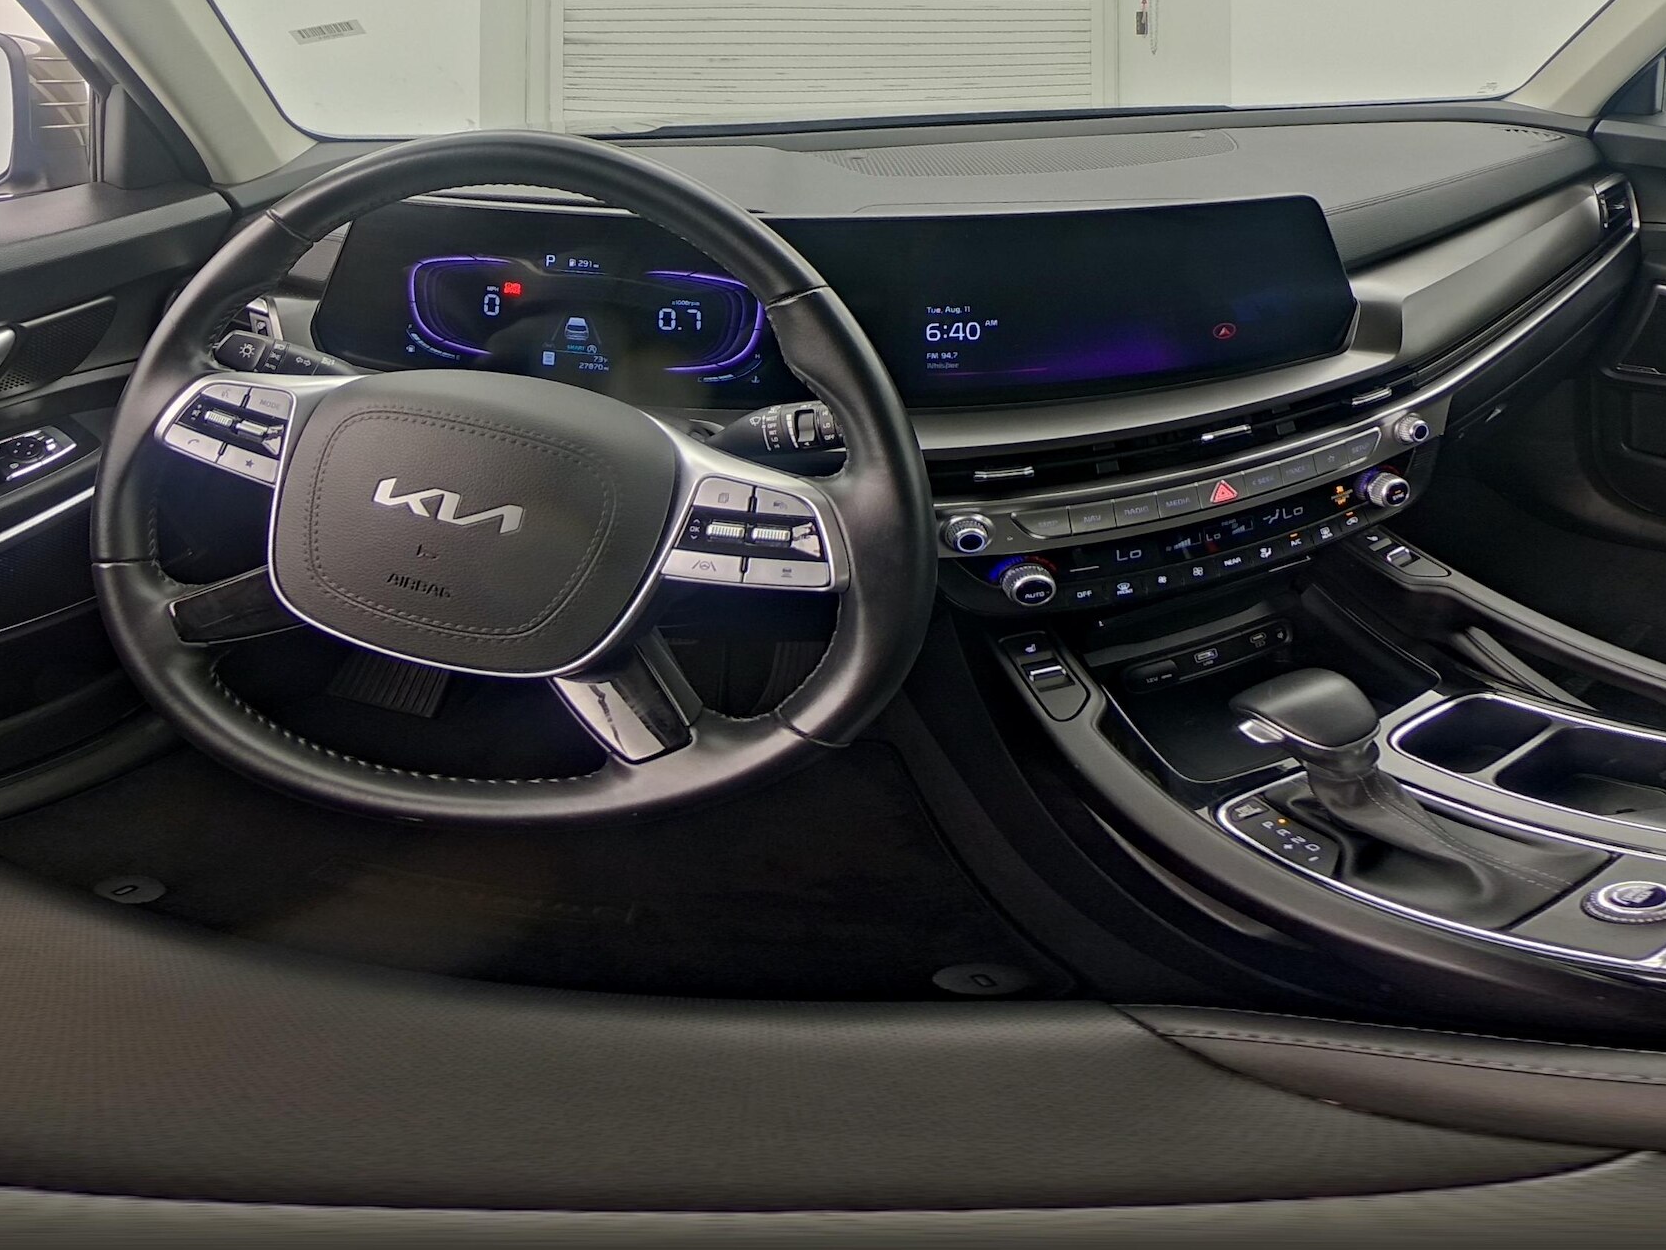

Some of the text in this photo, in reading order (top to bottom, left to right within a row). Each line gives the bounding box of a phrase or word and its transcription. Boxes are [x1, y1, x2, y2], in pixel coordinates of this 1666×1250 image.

[545, 254, 556, 267] P
[483, 293, 501, 316] 0
[658, 307, 702, 331] 0.7
[925, 319, 998, 342] 6:40 AM
[926, 352, 939, 360] FM
[373, 477, 524, 534] KIA
[1024, 590, 1046, 600] AUTO
[1076, 589, 1093, 599] OFF
